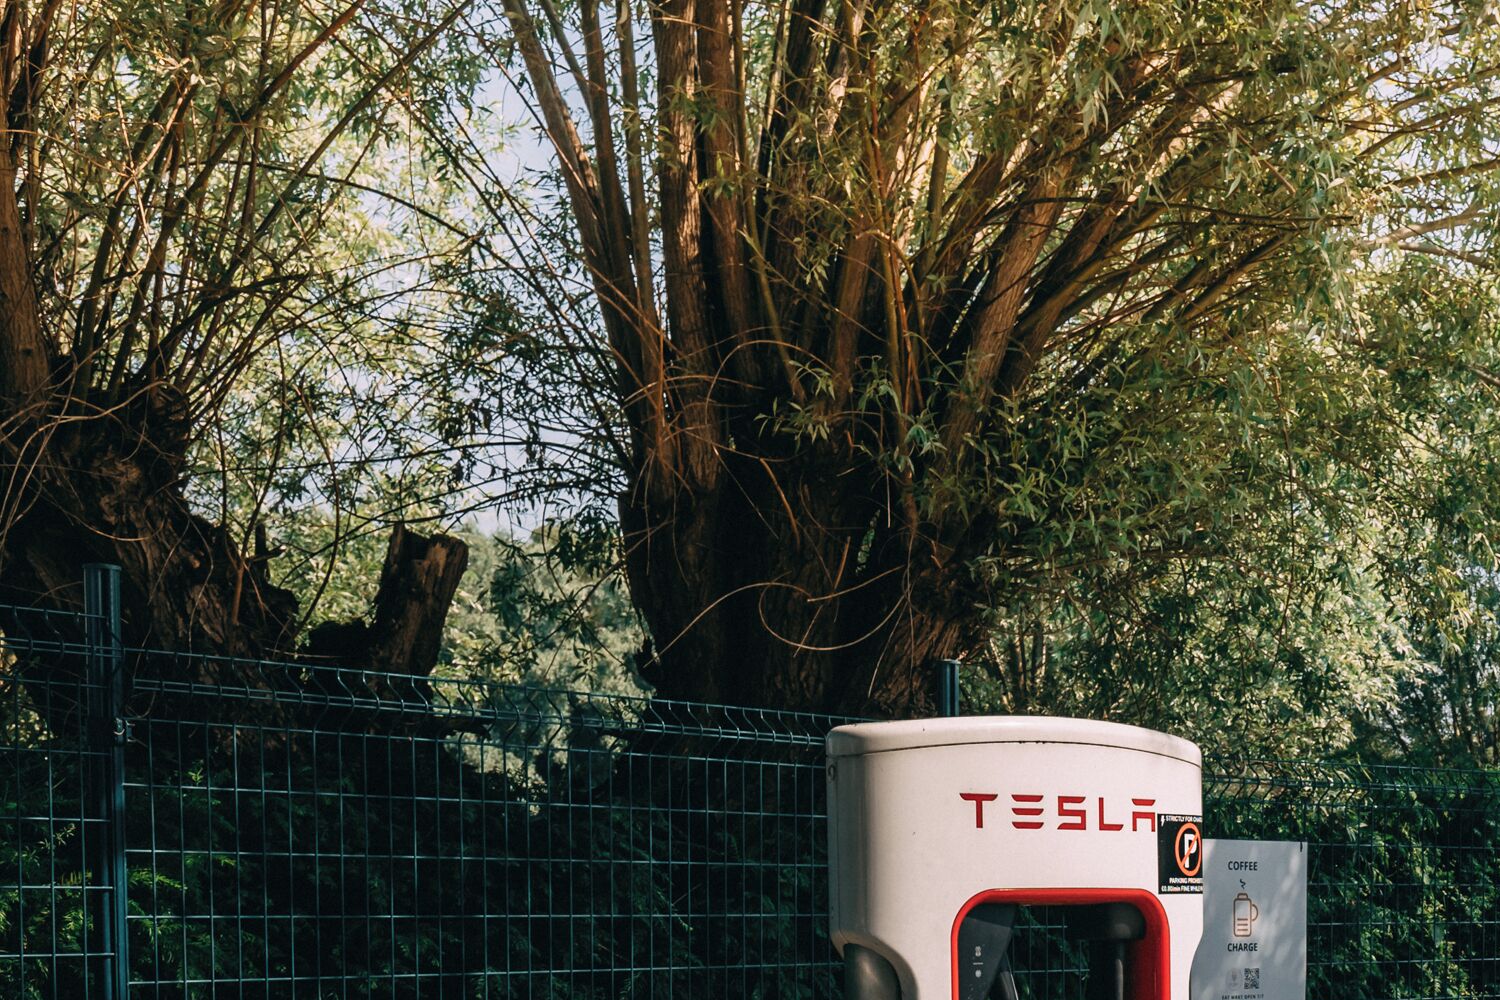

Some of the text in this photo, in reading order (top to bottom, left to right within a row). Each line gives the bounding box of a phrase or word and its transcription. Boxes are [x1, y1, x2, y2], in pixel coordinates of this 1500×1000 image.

[959, 793, 1156, 832] TESLA
[1228, 861, 1258, 871] COFFEE
[1227, 943, 1258, 952] CHARGE
